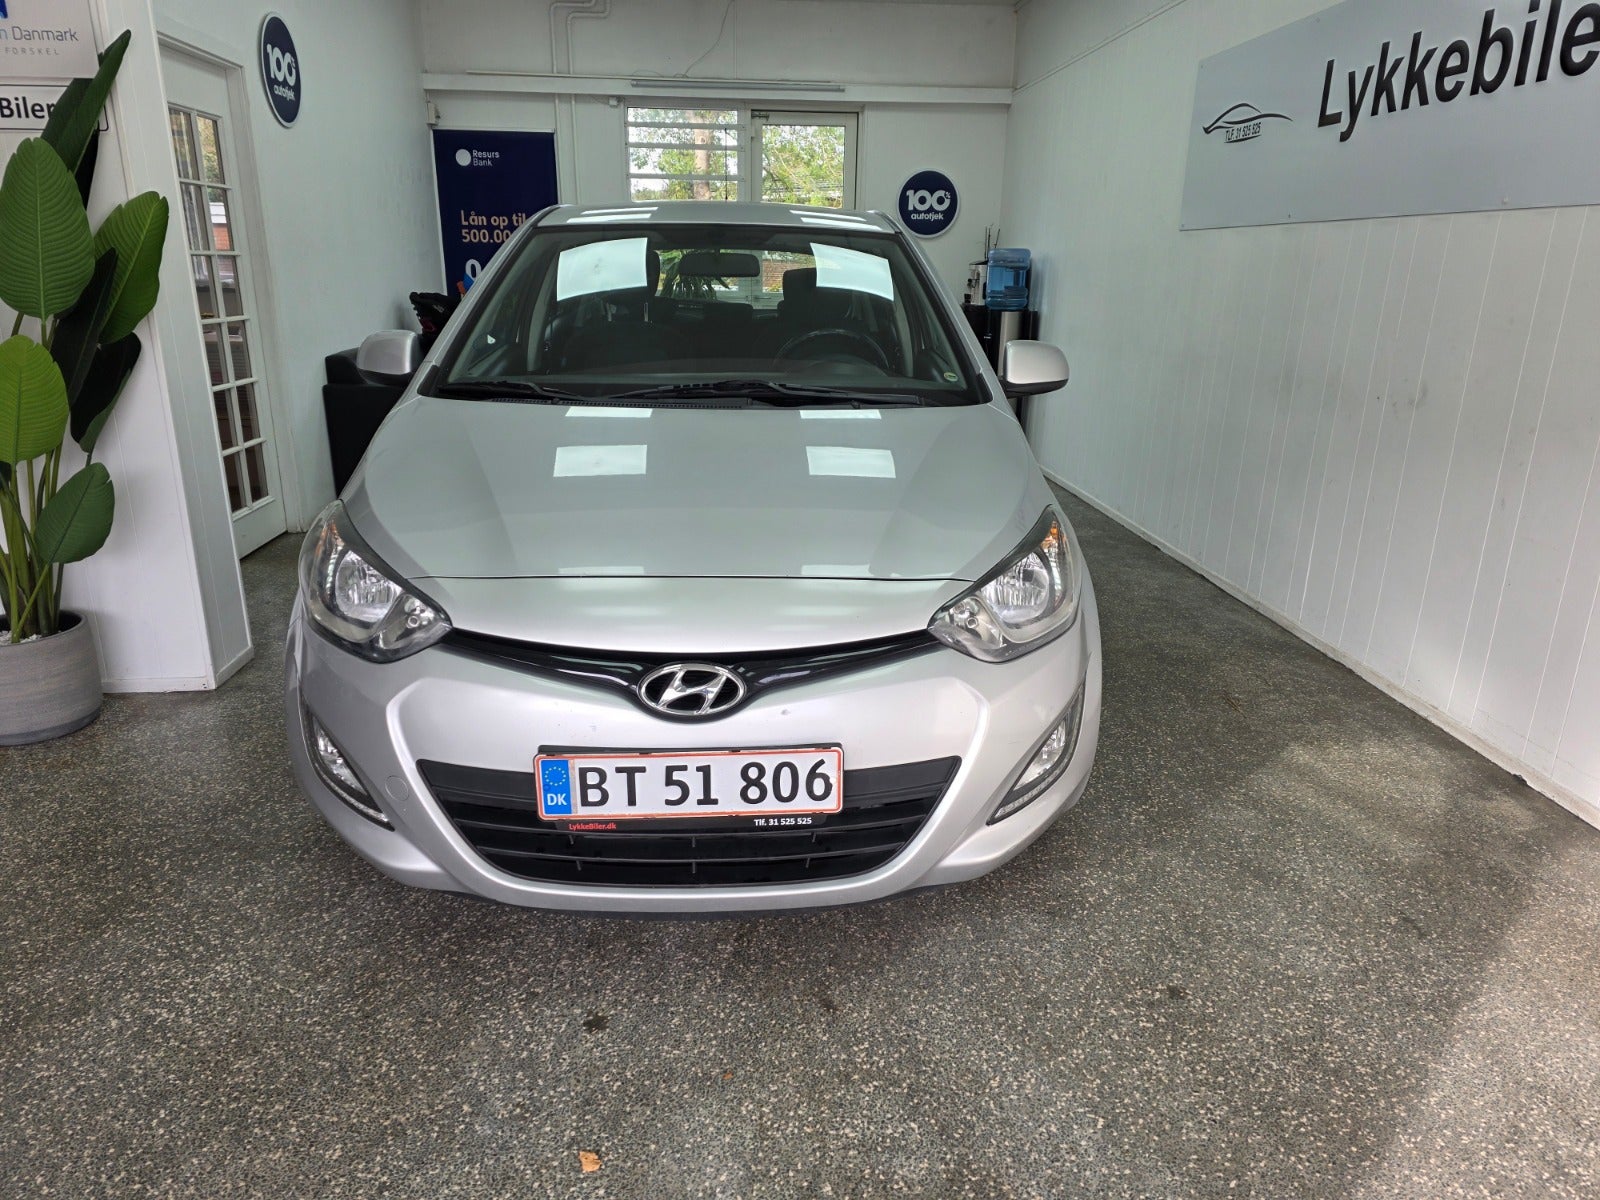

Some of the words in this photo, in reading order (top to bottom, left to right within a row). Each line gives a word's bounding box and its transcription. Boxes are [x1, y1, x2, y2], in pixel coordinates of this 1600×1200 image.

[12, 26, 79, 41] Danmark
[5, 47, 60, 56] FORSKEL
[1317, 0, 1600, 142] Lykkebile
[0, 96, 56, 119] Biler
[1235, 126, 1242, 139] 31
[1242, 124, 1252, 137] 525
[1252, 121, 1262, 135] 525
[473, 150, 500, 159] Resurs
[473, 158, 493, 167] Bank
[461, 210, 487, 226] Lån
[491, 216, 509, 230] op
[512, 212, 527, 227] til
[911, 211, 944, 222] autotjek
[578, 765, 647, 808] BT
[664, 764, 719, 807] 51
[739, 758, 834, 805] 806
[546, 793, 568, 806] DK
[568, 822, 617, 832] LykkeBiler.dk
[754, 818, 767, 826] Tlf.
[768, 818, 779, 826] 31
[780, 818, 796, 826] 525
[797, 817, 812, 825] 525
